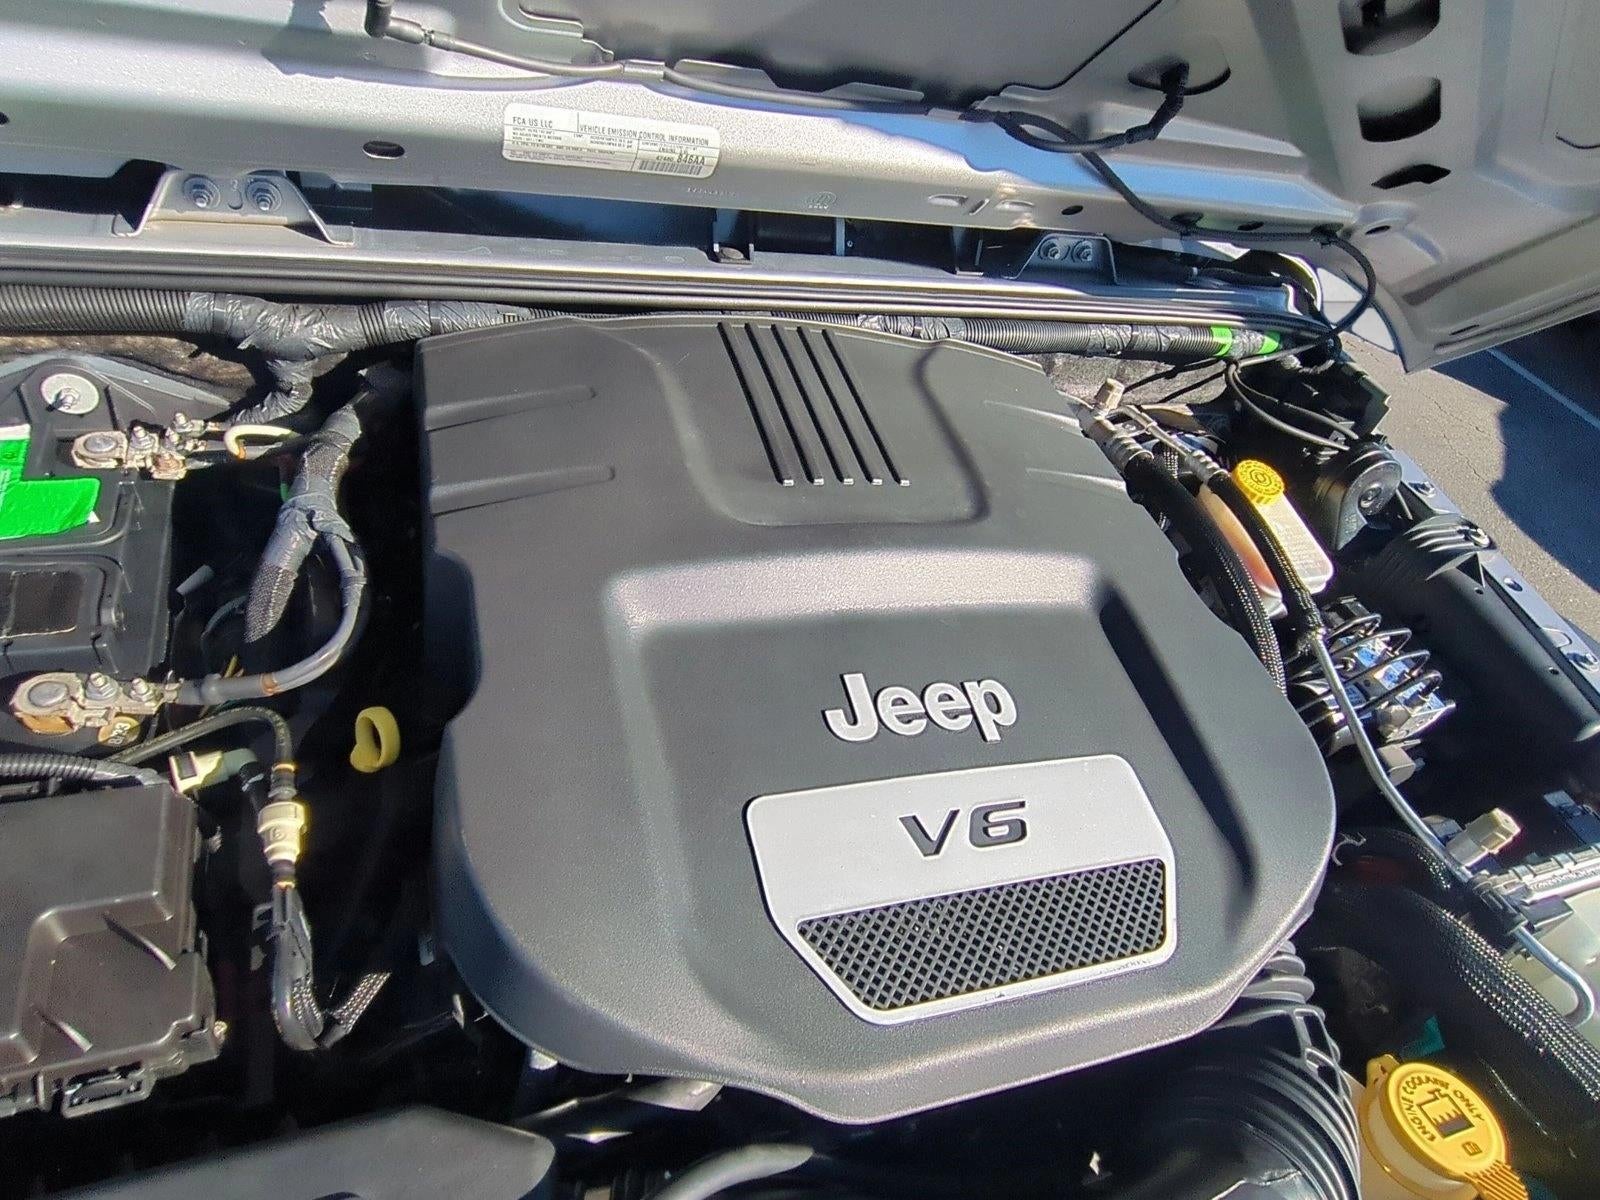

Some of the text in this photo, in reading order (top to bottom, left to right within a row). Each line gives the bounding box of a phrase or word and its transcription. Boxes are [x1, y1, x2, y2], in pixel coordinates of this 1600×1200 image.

[512, 116, 553, 129] FCA US LLC
[580, 125, 605, 135] VEHICLE
[607, 127, 637, 138] EMISSION
[638, 131, 666, 141] CONTROL
[669, 134, 709, 146] INFORMATION
[822, 673, 1018, 742] Jeep
[899, 800, 1028, 858] V6
[1401, 1096, 1436, 1143] ENGINE
[1453, 1089, 1487, 1122] ONLY
